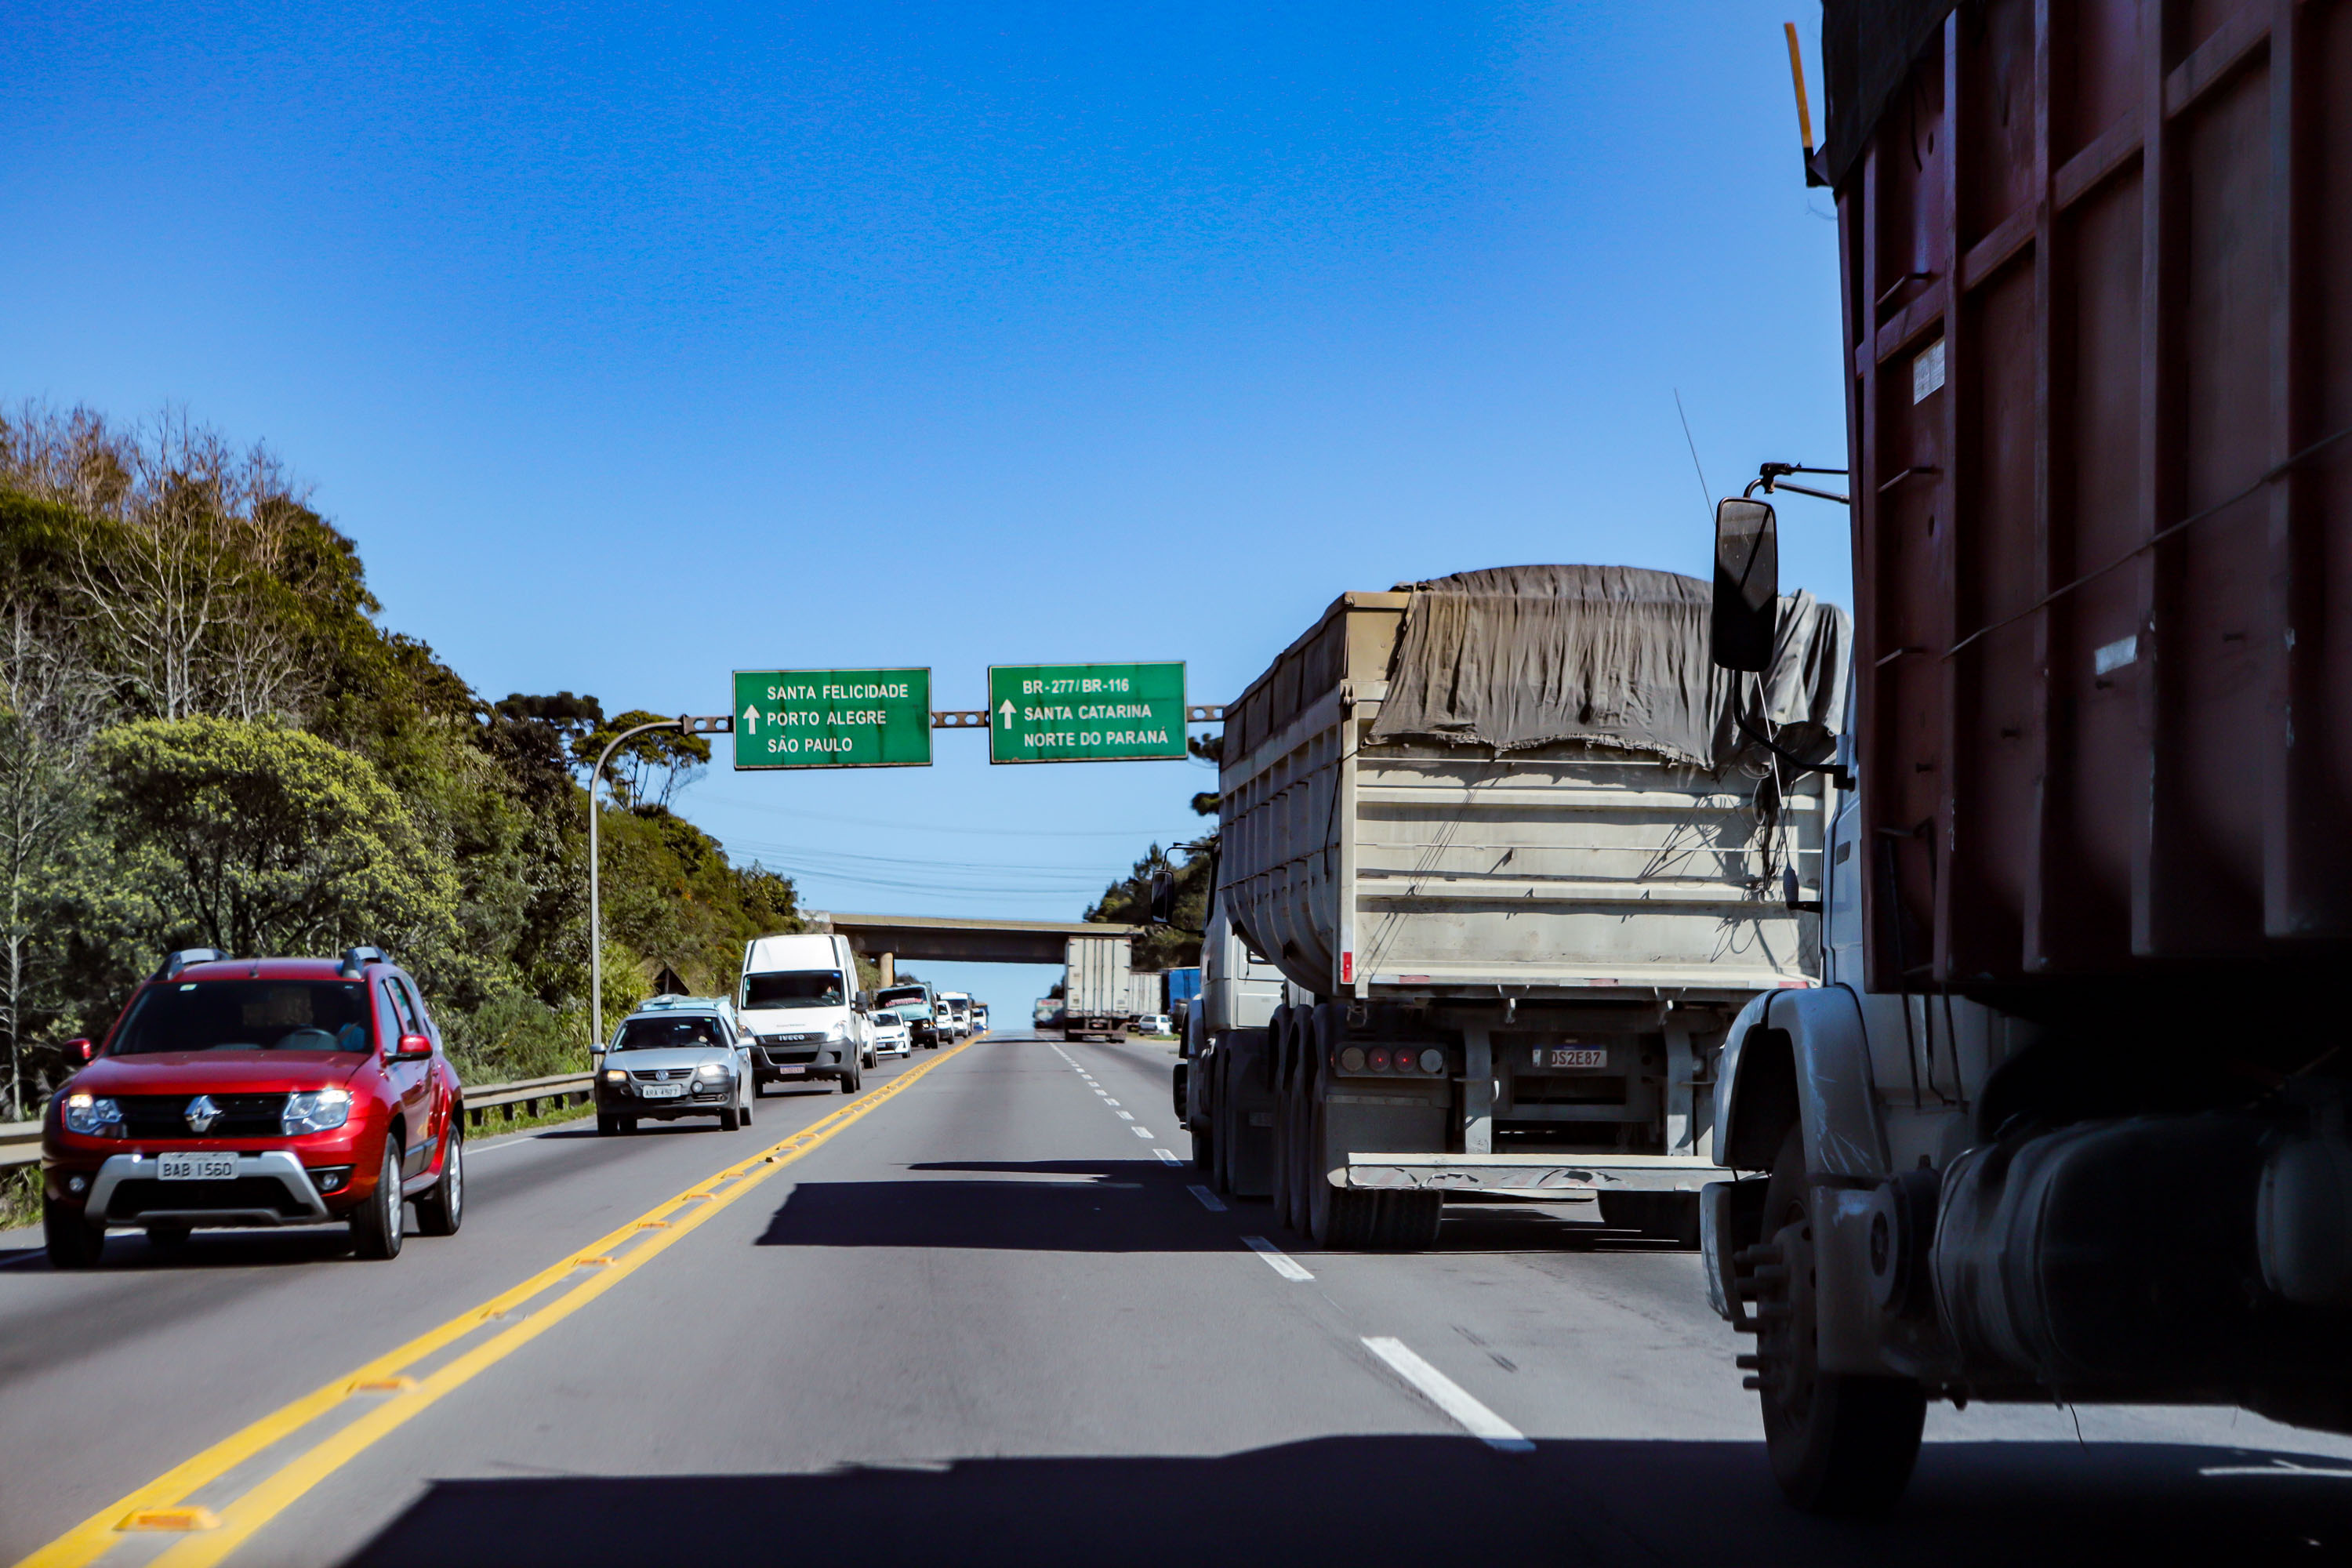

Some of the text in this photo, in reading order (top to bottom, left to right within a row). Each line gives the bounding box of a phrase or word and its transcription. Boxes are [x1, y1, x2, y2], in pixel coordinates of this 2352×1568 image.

[768, 684, 909, 700] SANTA FELICIDADE
[1022, 678, 1130, 695] BR-277/BR-116
[768, 710, 887, 726] PORTO ALEGRE
[1024, 704, 1152, 721] SANTA CATARINA
[768, 735, 853, 753] SÃO PAULO
[1024, 726, 1169, 747] NORTE DO PARANÁ
[163, 1162, 232, 1177] BAB 1560
